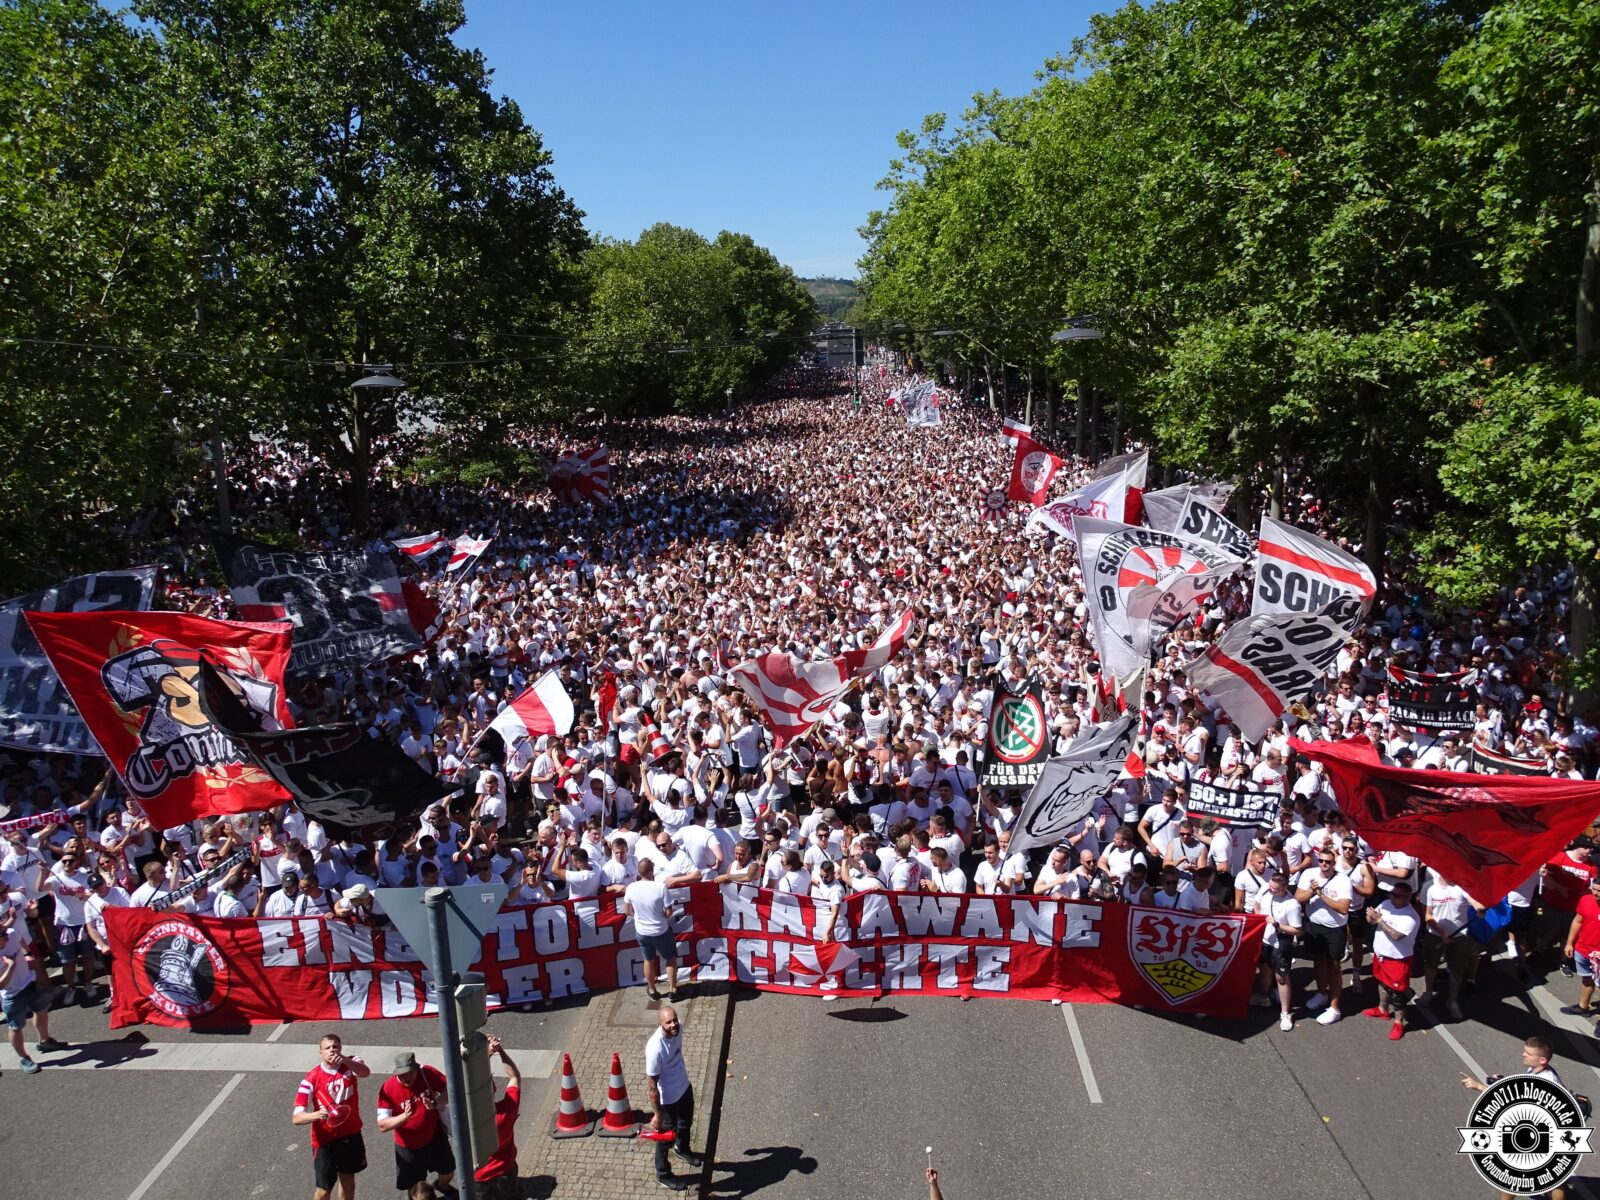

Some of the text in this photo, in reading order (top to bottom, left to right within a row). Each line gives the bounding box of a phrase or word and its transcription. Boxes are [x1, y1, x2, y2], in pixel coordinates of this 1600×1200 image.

[989, 762, 1015, 776] FÜR
[982, 774, 1040, 786] FUSSBA
[149, 990, 216, 1016] KURVE
